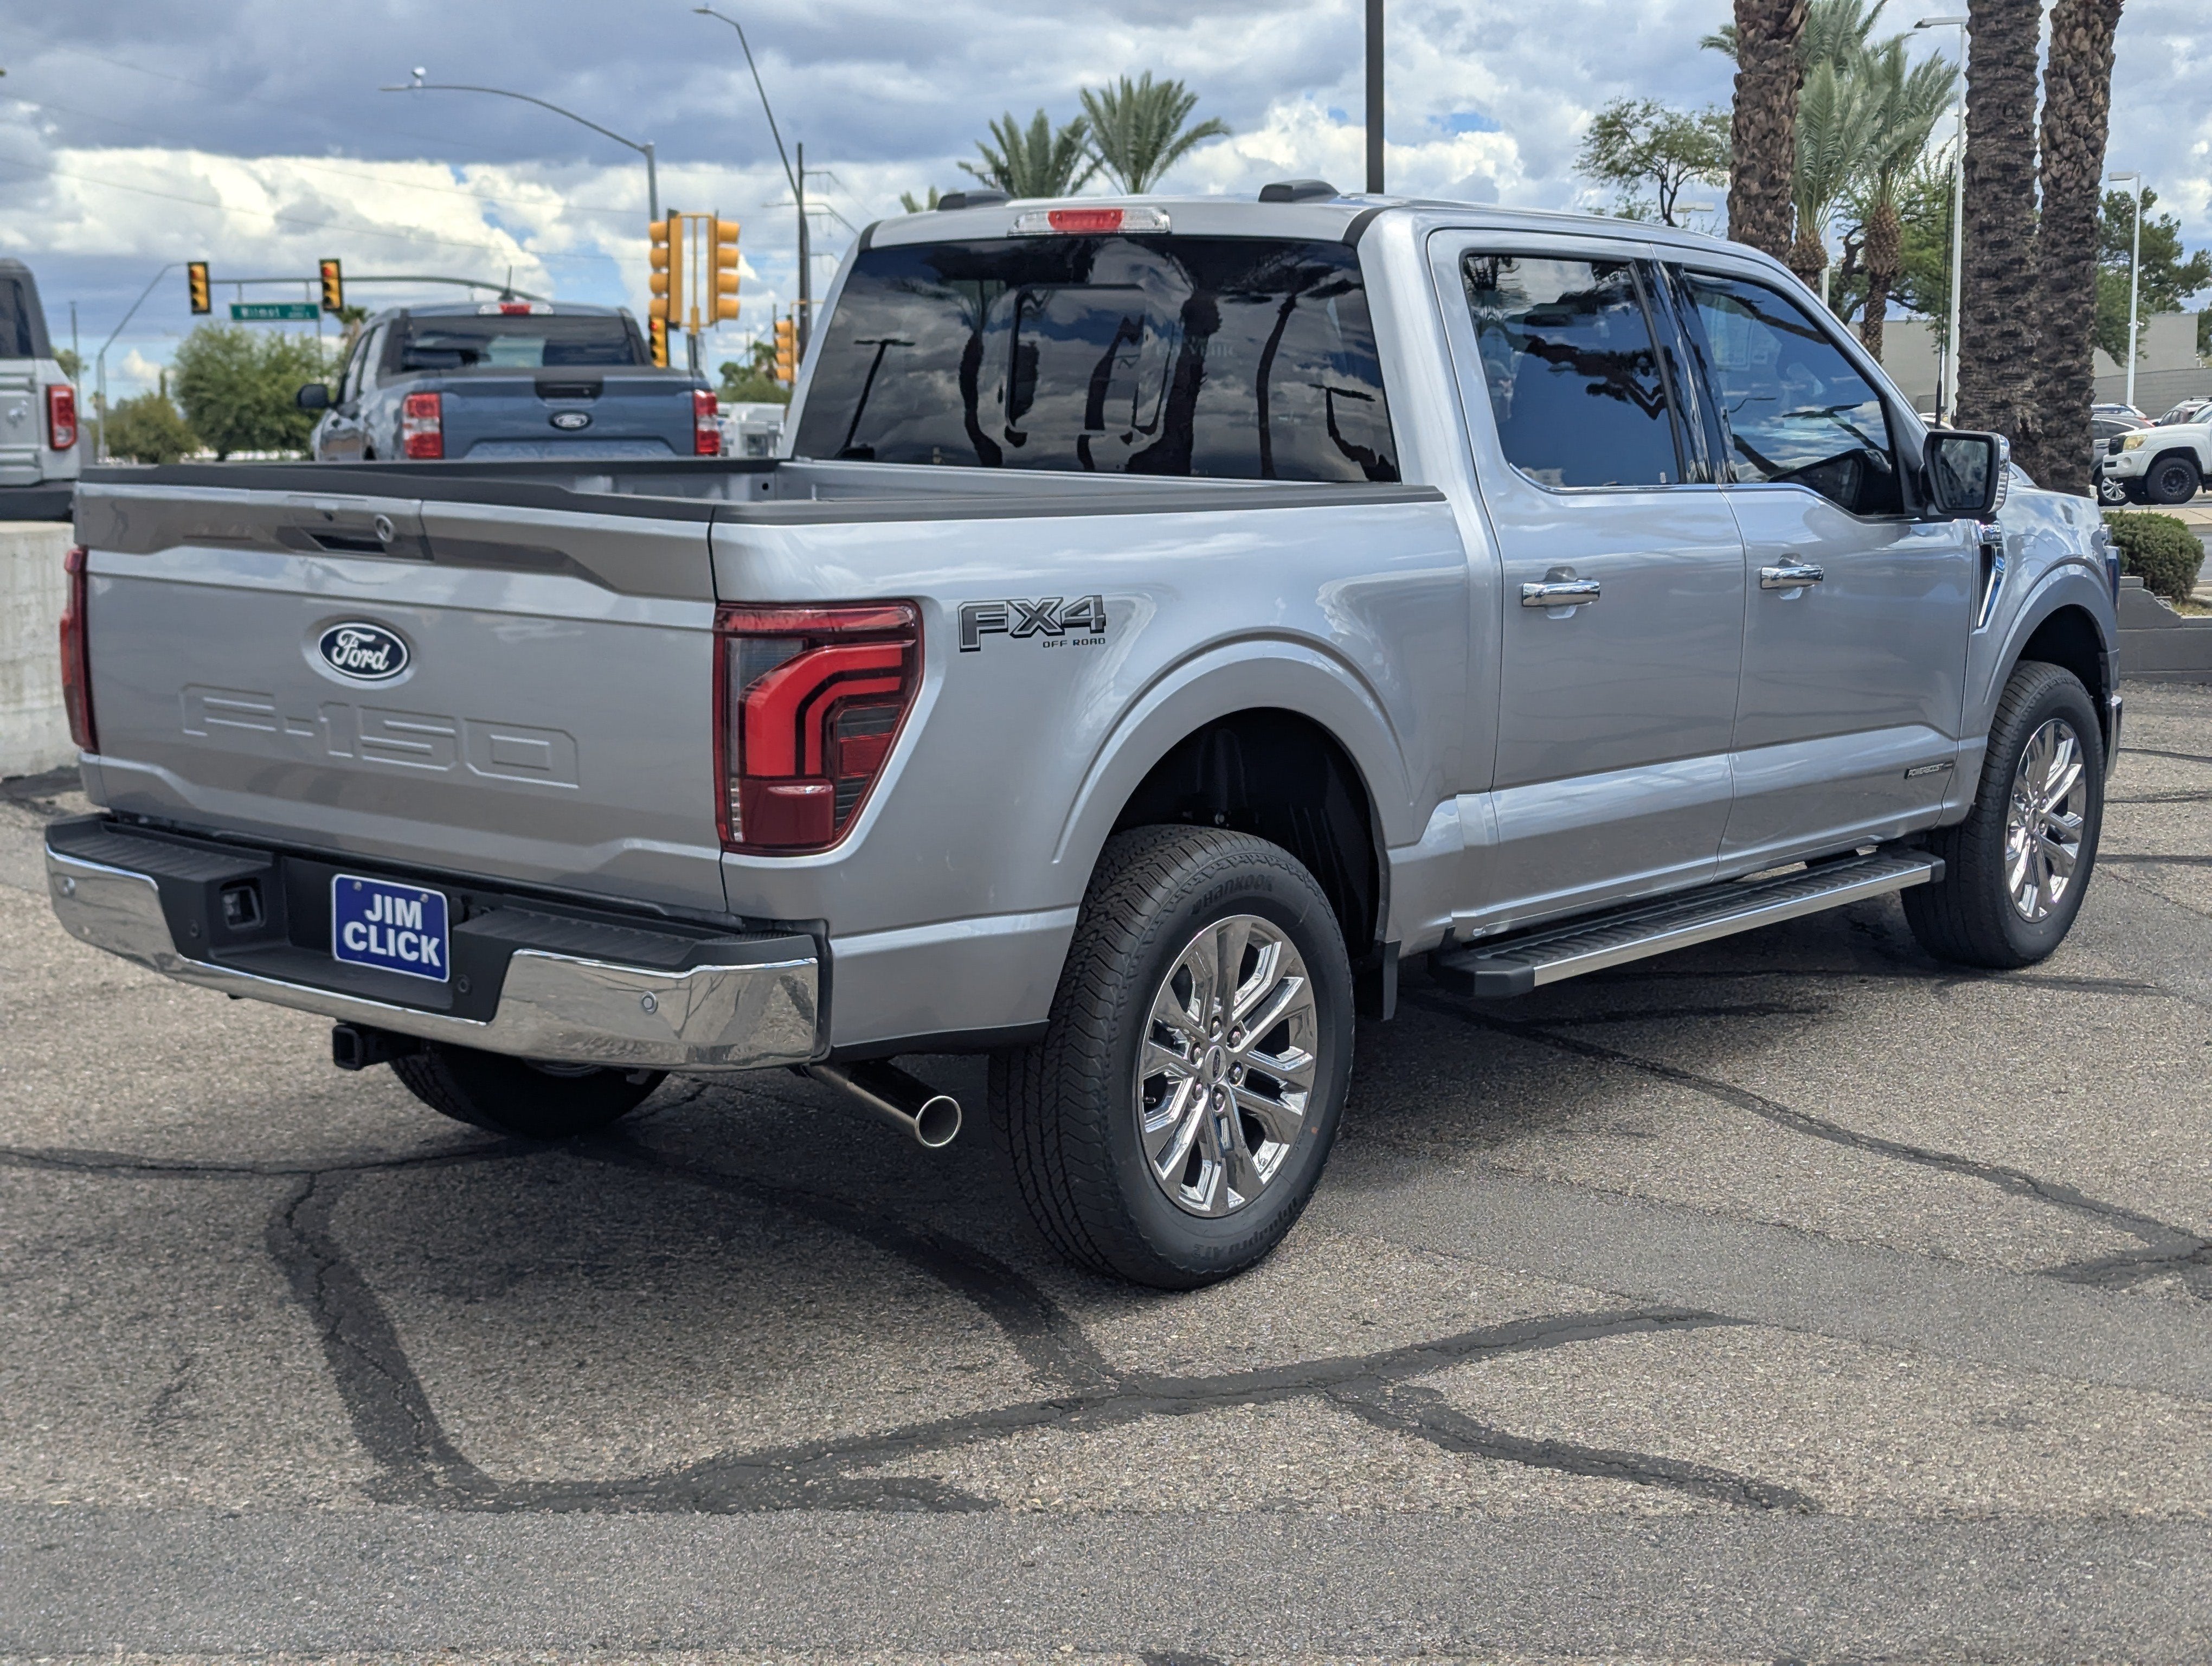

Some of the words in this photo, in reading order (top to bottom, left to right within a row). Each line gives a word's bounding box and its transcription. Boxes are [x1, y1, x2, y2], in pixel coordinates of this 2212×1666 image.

[957, 594, 1107, 652] FX4
[1043, 639, 1068, 648] OFF
[1072, 637, 1106, 646] ROAD
[331, 629, 391, 671] Ford
[177, 683, 580, 789] F-150
[363, 893, 423, 931] JIM
[343, 921, 442, 967] CLICK
